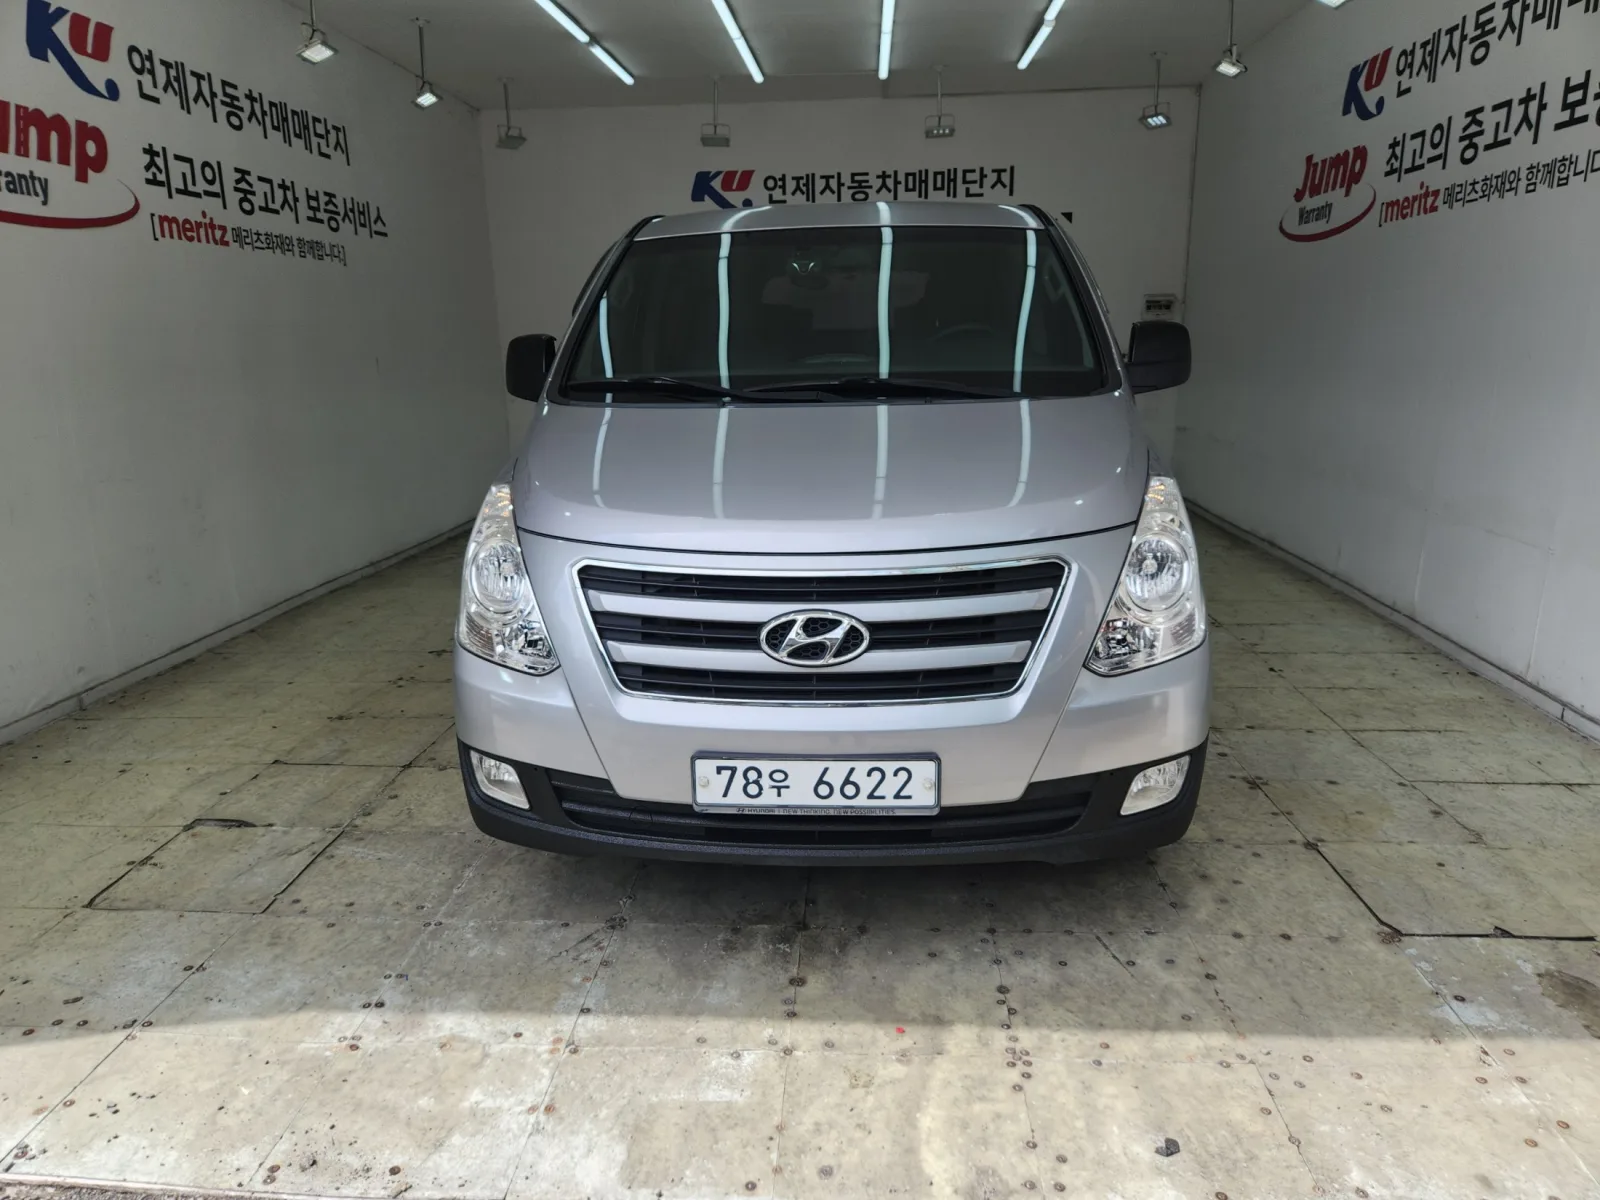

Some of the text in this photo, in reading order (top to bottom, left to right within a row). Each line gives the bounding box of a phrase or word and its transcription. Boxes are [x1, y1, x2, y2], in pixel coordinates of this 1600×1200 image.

[127, 44, 352, 166] 연제자동차매매단지
[1384, 115, 1452, 182] 최고의
[1458, 81, 1548, 165] 중고차
[142, 143, 389, 239] 최고의 중고차 보증서비스
[763, 165, 1015, 205] 연제자동차매매단지
[1293, 144, 1369, 203] Jump
[1442, 166, 1522, 209] 메리츠화재와
[1298, 200, 1333, 226] Warranty
[231, 226, 296, 257] 메리츠화재와
[716, 765, 913, 800] 78우 6622
